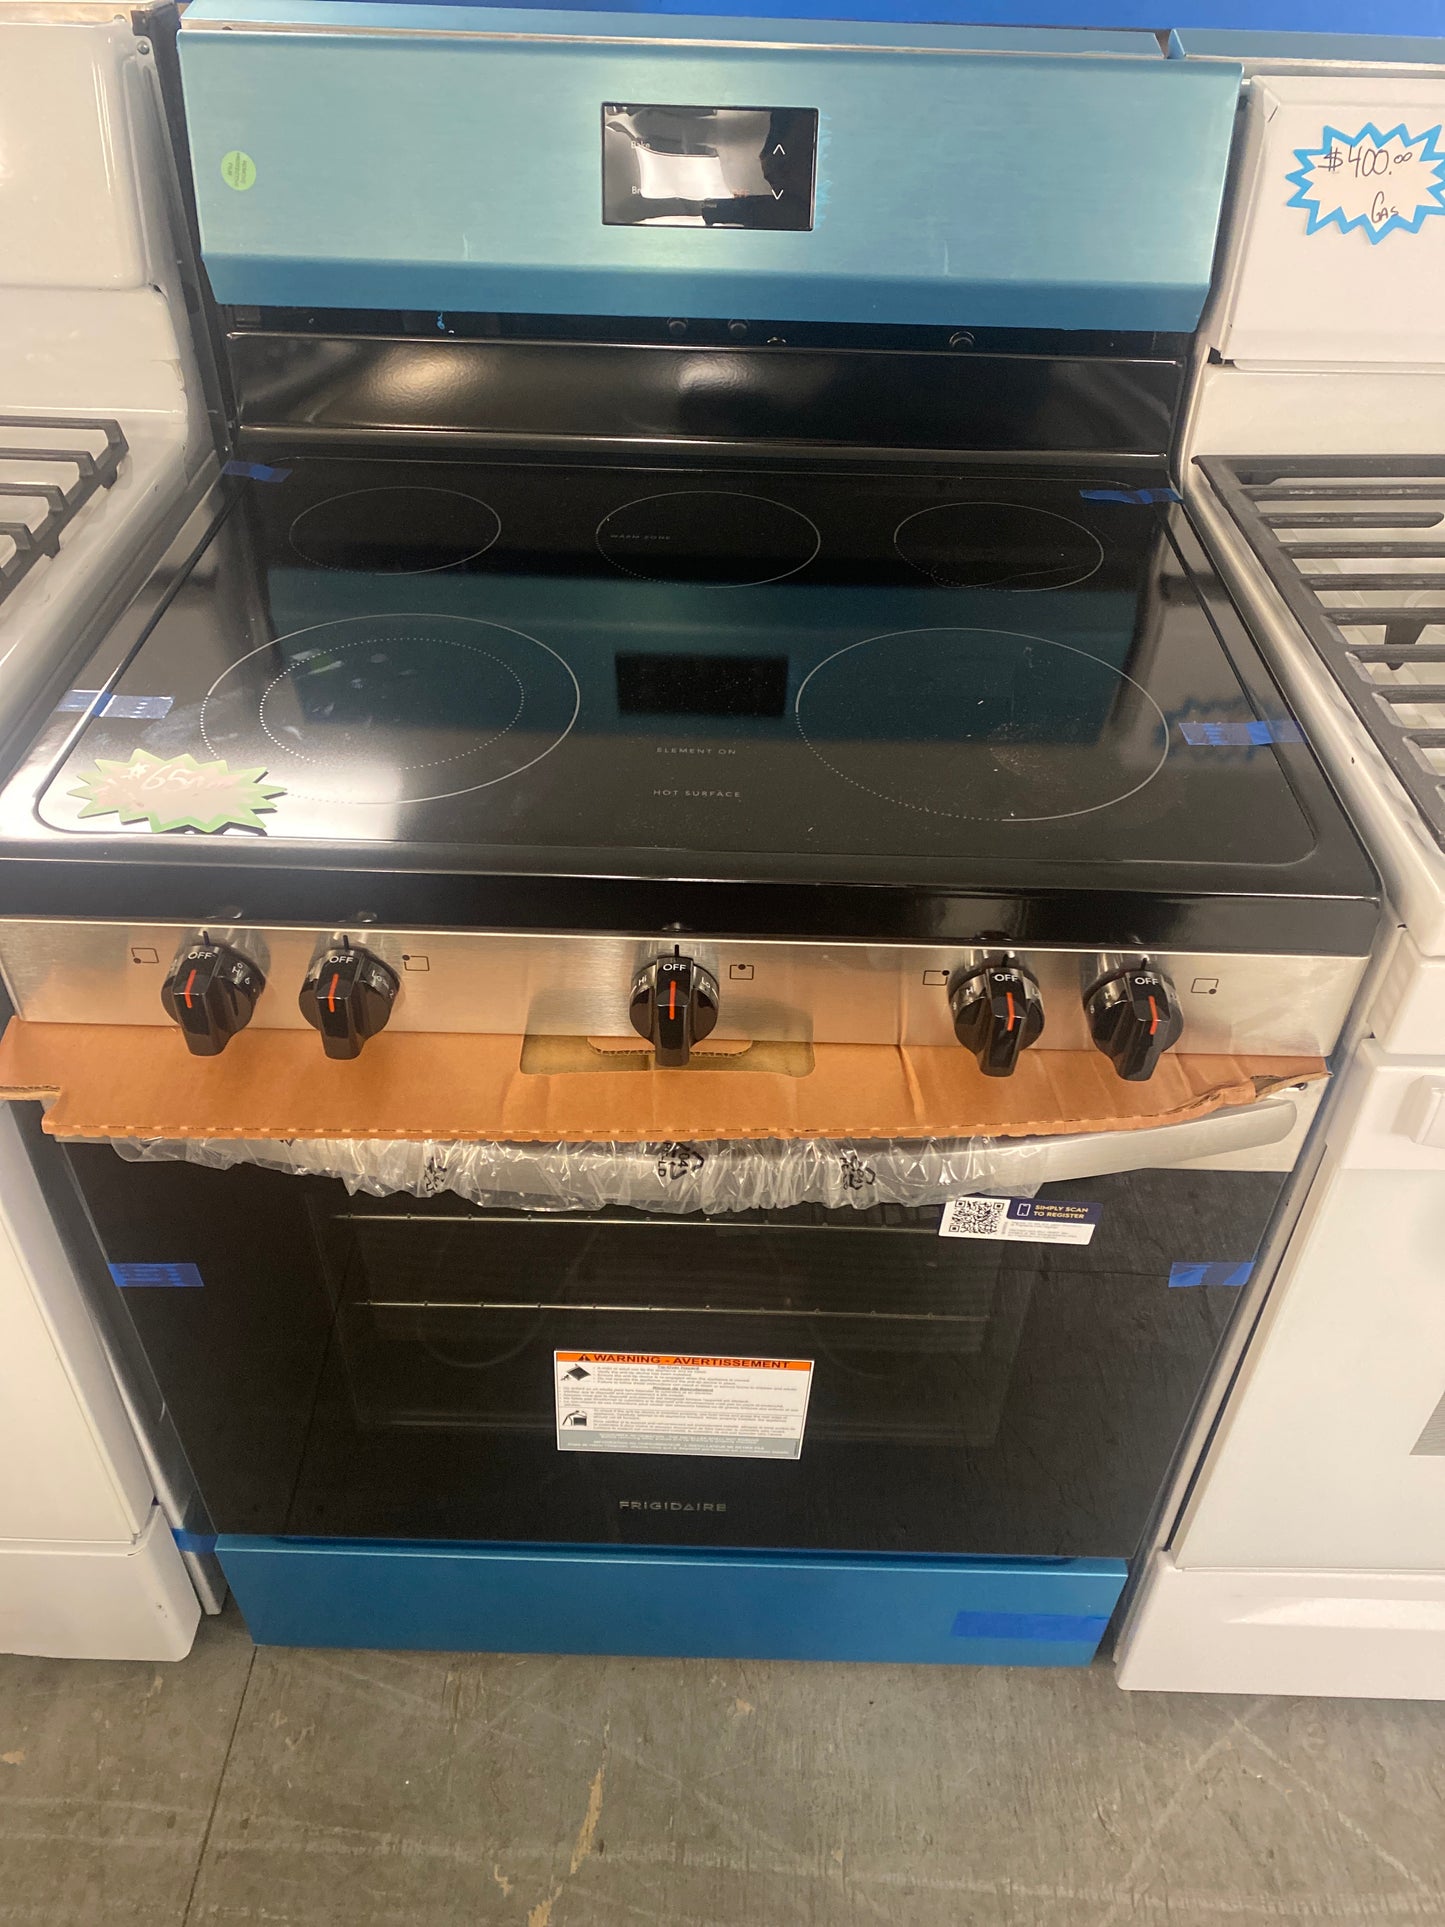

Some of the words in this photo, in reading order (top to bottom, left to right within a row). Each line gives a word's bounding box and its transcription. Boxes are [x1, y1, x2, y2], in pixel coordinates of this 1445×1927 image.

[656, 746, 713, 754] ELEMENT
[685, 790, 741, 798] SURFACE
[188, 951, 213, 960] OFF
[329, 955, 354, 964] OFF
[662, 963, 687, 971] OFF
[994, 973, 1018, 982] OFF
[1134, 977, 1159, 985] OFF
[1034, 1204, 1064, 1212] SIMPLY
[1046, 1211, 1085, 1219] REGISTER
[593, 1354, 661, 1364] WARNING
[673, 1356, 791, 1369] AVERTISSEMENT
[619, 1501, 727, 1512] FRIGIDAIRE
